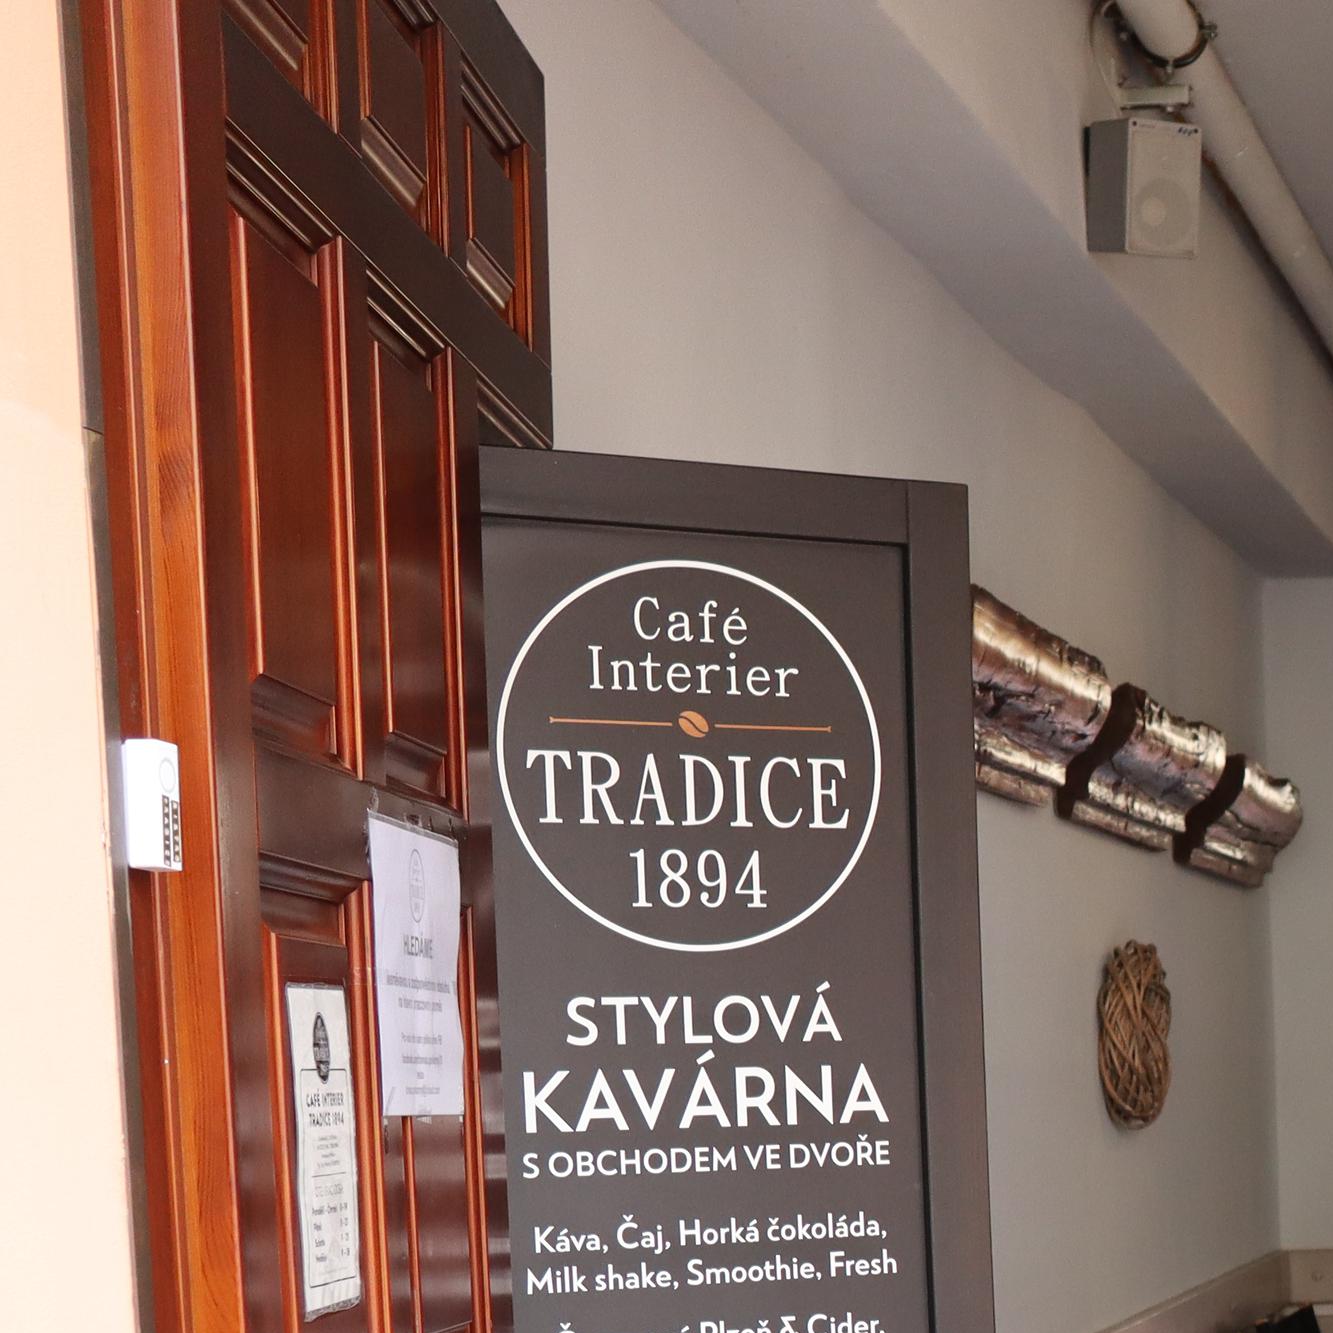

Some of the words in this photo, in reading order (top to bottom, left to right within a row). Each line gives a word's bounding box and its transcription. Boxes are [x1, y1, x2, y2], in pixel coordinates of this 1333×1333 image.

[633, 596, 748, 646] Café
[587, 645, 799, 697] Interier
[526, 749, 850, 829] TRADICE
[629, 848, 768, 908] 1894
[566, 980, 843, 1047] STYLOVÁ
[522, 1049, 890, 1134] KAVÁRNA
[522, 1152, 540, 1179] S
[548, 1146, 737, 1178] OBCHODEM
[742, 1144, 782, 1170] VE
[789, 1133, 891, 1169] DVOŘE
[534, 1225, 609, 1254] Káva,
[616, 1214, 671, 1255] Čaj,
[679, 1217, 760, 1246] Horká
[766, 1210, 887, 1242] čokoláda,
[527, 1265, 589, 1295] Milk
[594, 1261, 679, 1292] shake,
[686, 1254, 822, 1286] Smoothie,
[829, 1248, 898, 1278] Fresh
